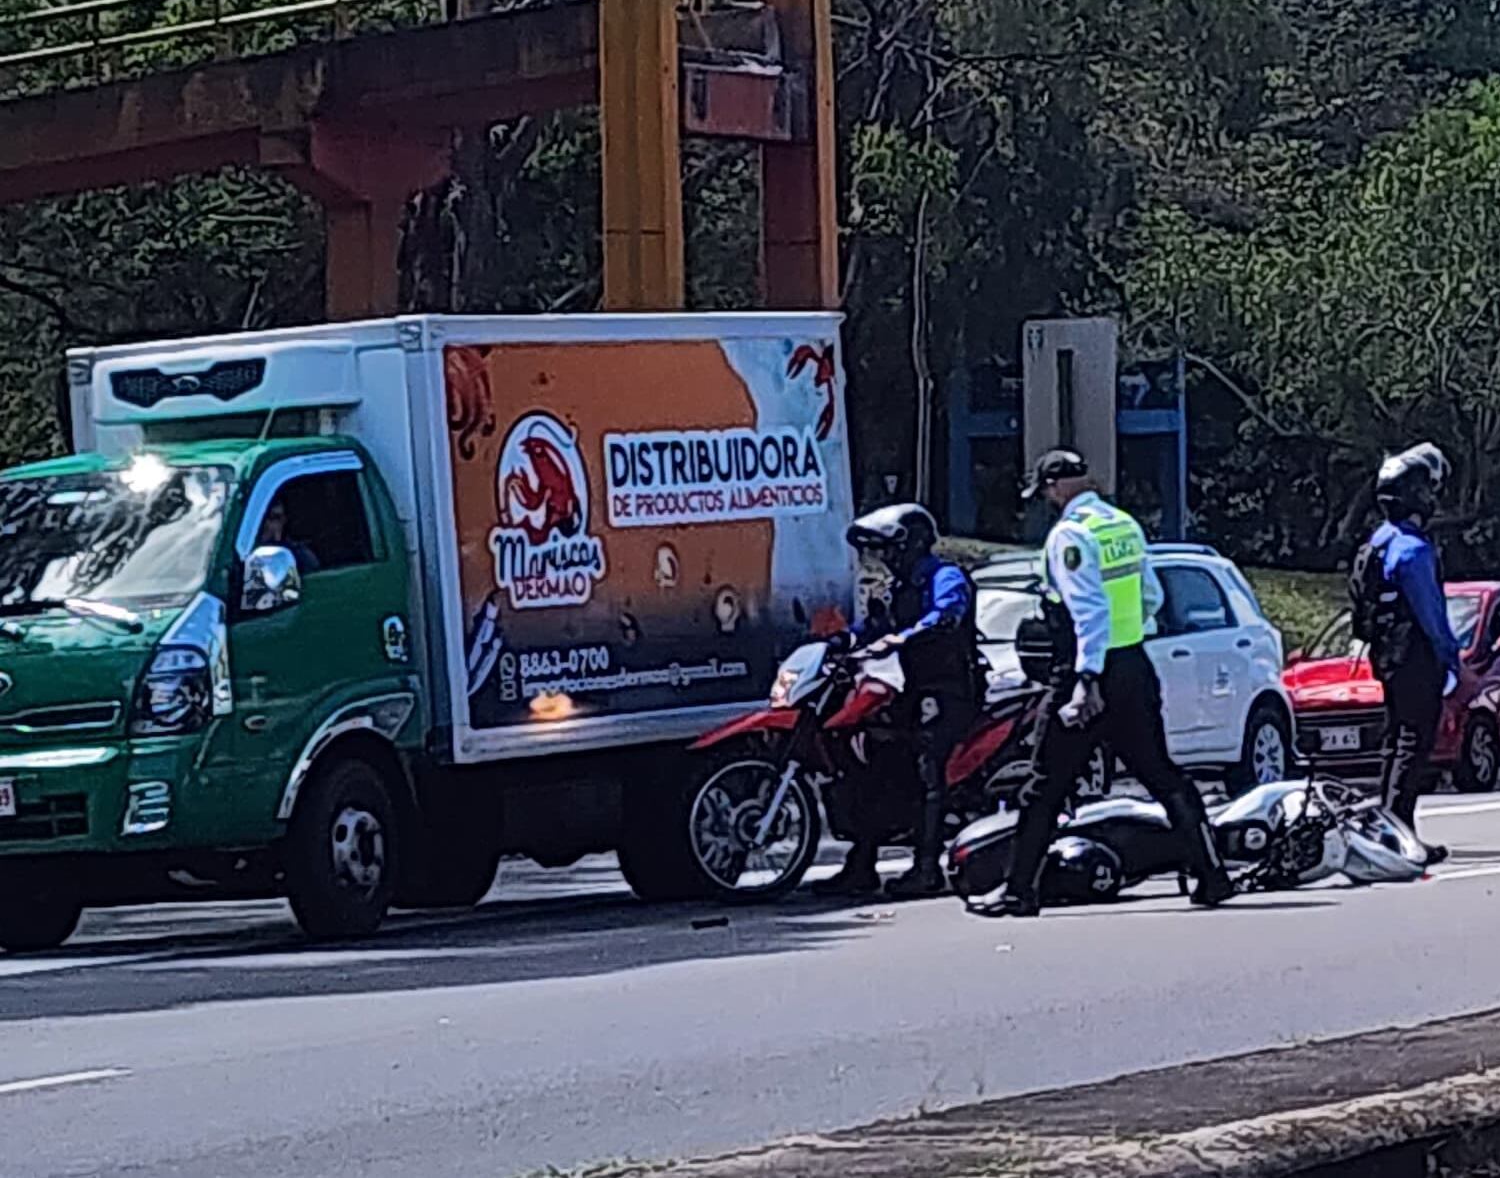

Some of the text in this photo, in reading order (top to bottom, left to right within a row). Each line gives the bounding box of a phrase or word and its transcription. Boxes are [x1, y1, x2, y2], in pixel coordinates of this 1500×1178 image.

[610, 436, 821, 487] DISTRIBUIDORA
[613, 483, 823, 518] DE PRODUCTOS ALIMENTICIOS
[494, 534, 601, 582] Mariscos
